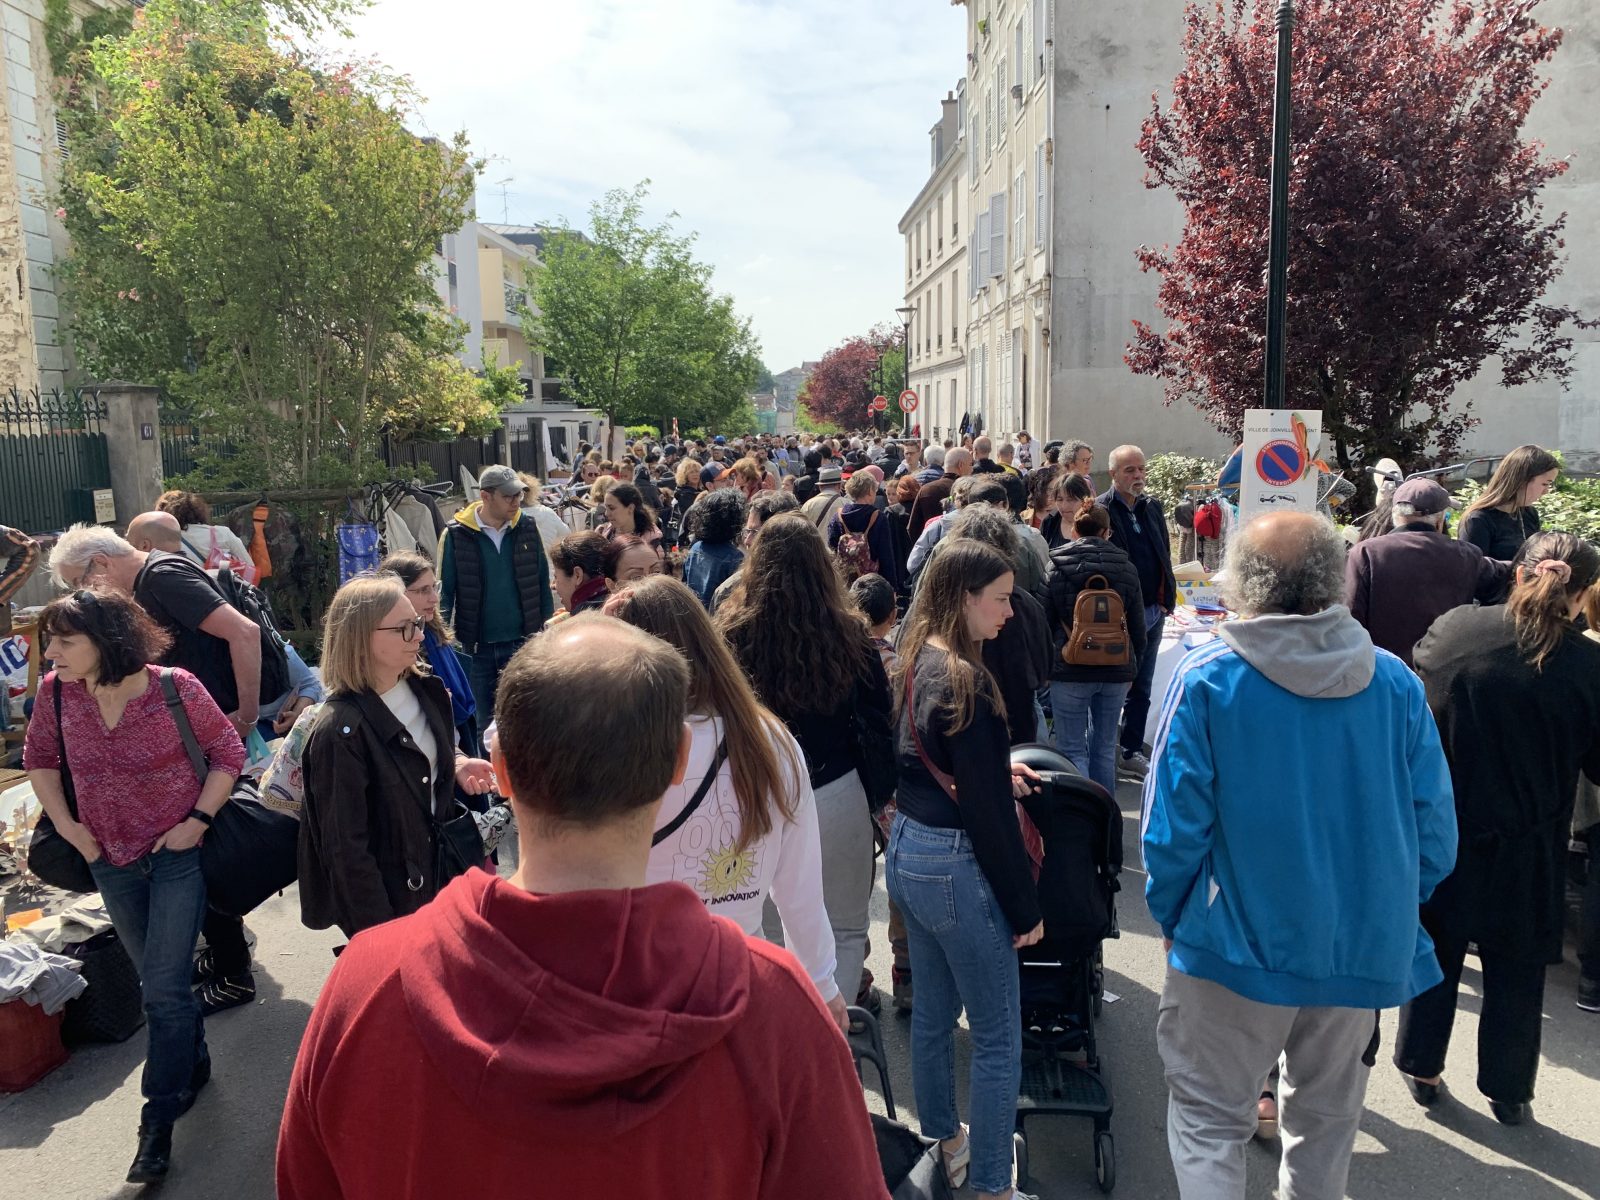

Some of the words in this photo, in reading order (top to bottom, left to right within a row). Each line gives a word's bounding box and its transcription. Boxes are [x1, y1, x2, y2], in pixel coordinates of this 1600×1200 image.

[1261, 440, 1301, 453] STATIONNEMENT
[1266, 478, 1293, 486] INTERDIT
[711, 888, 760, 905] INNOVATION
